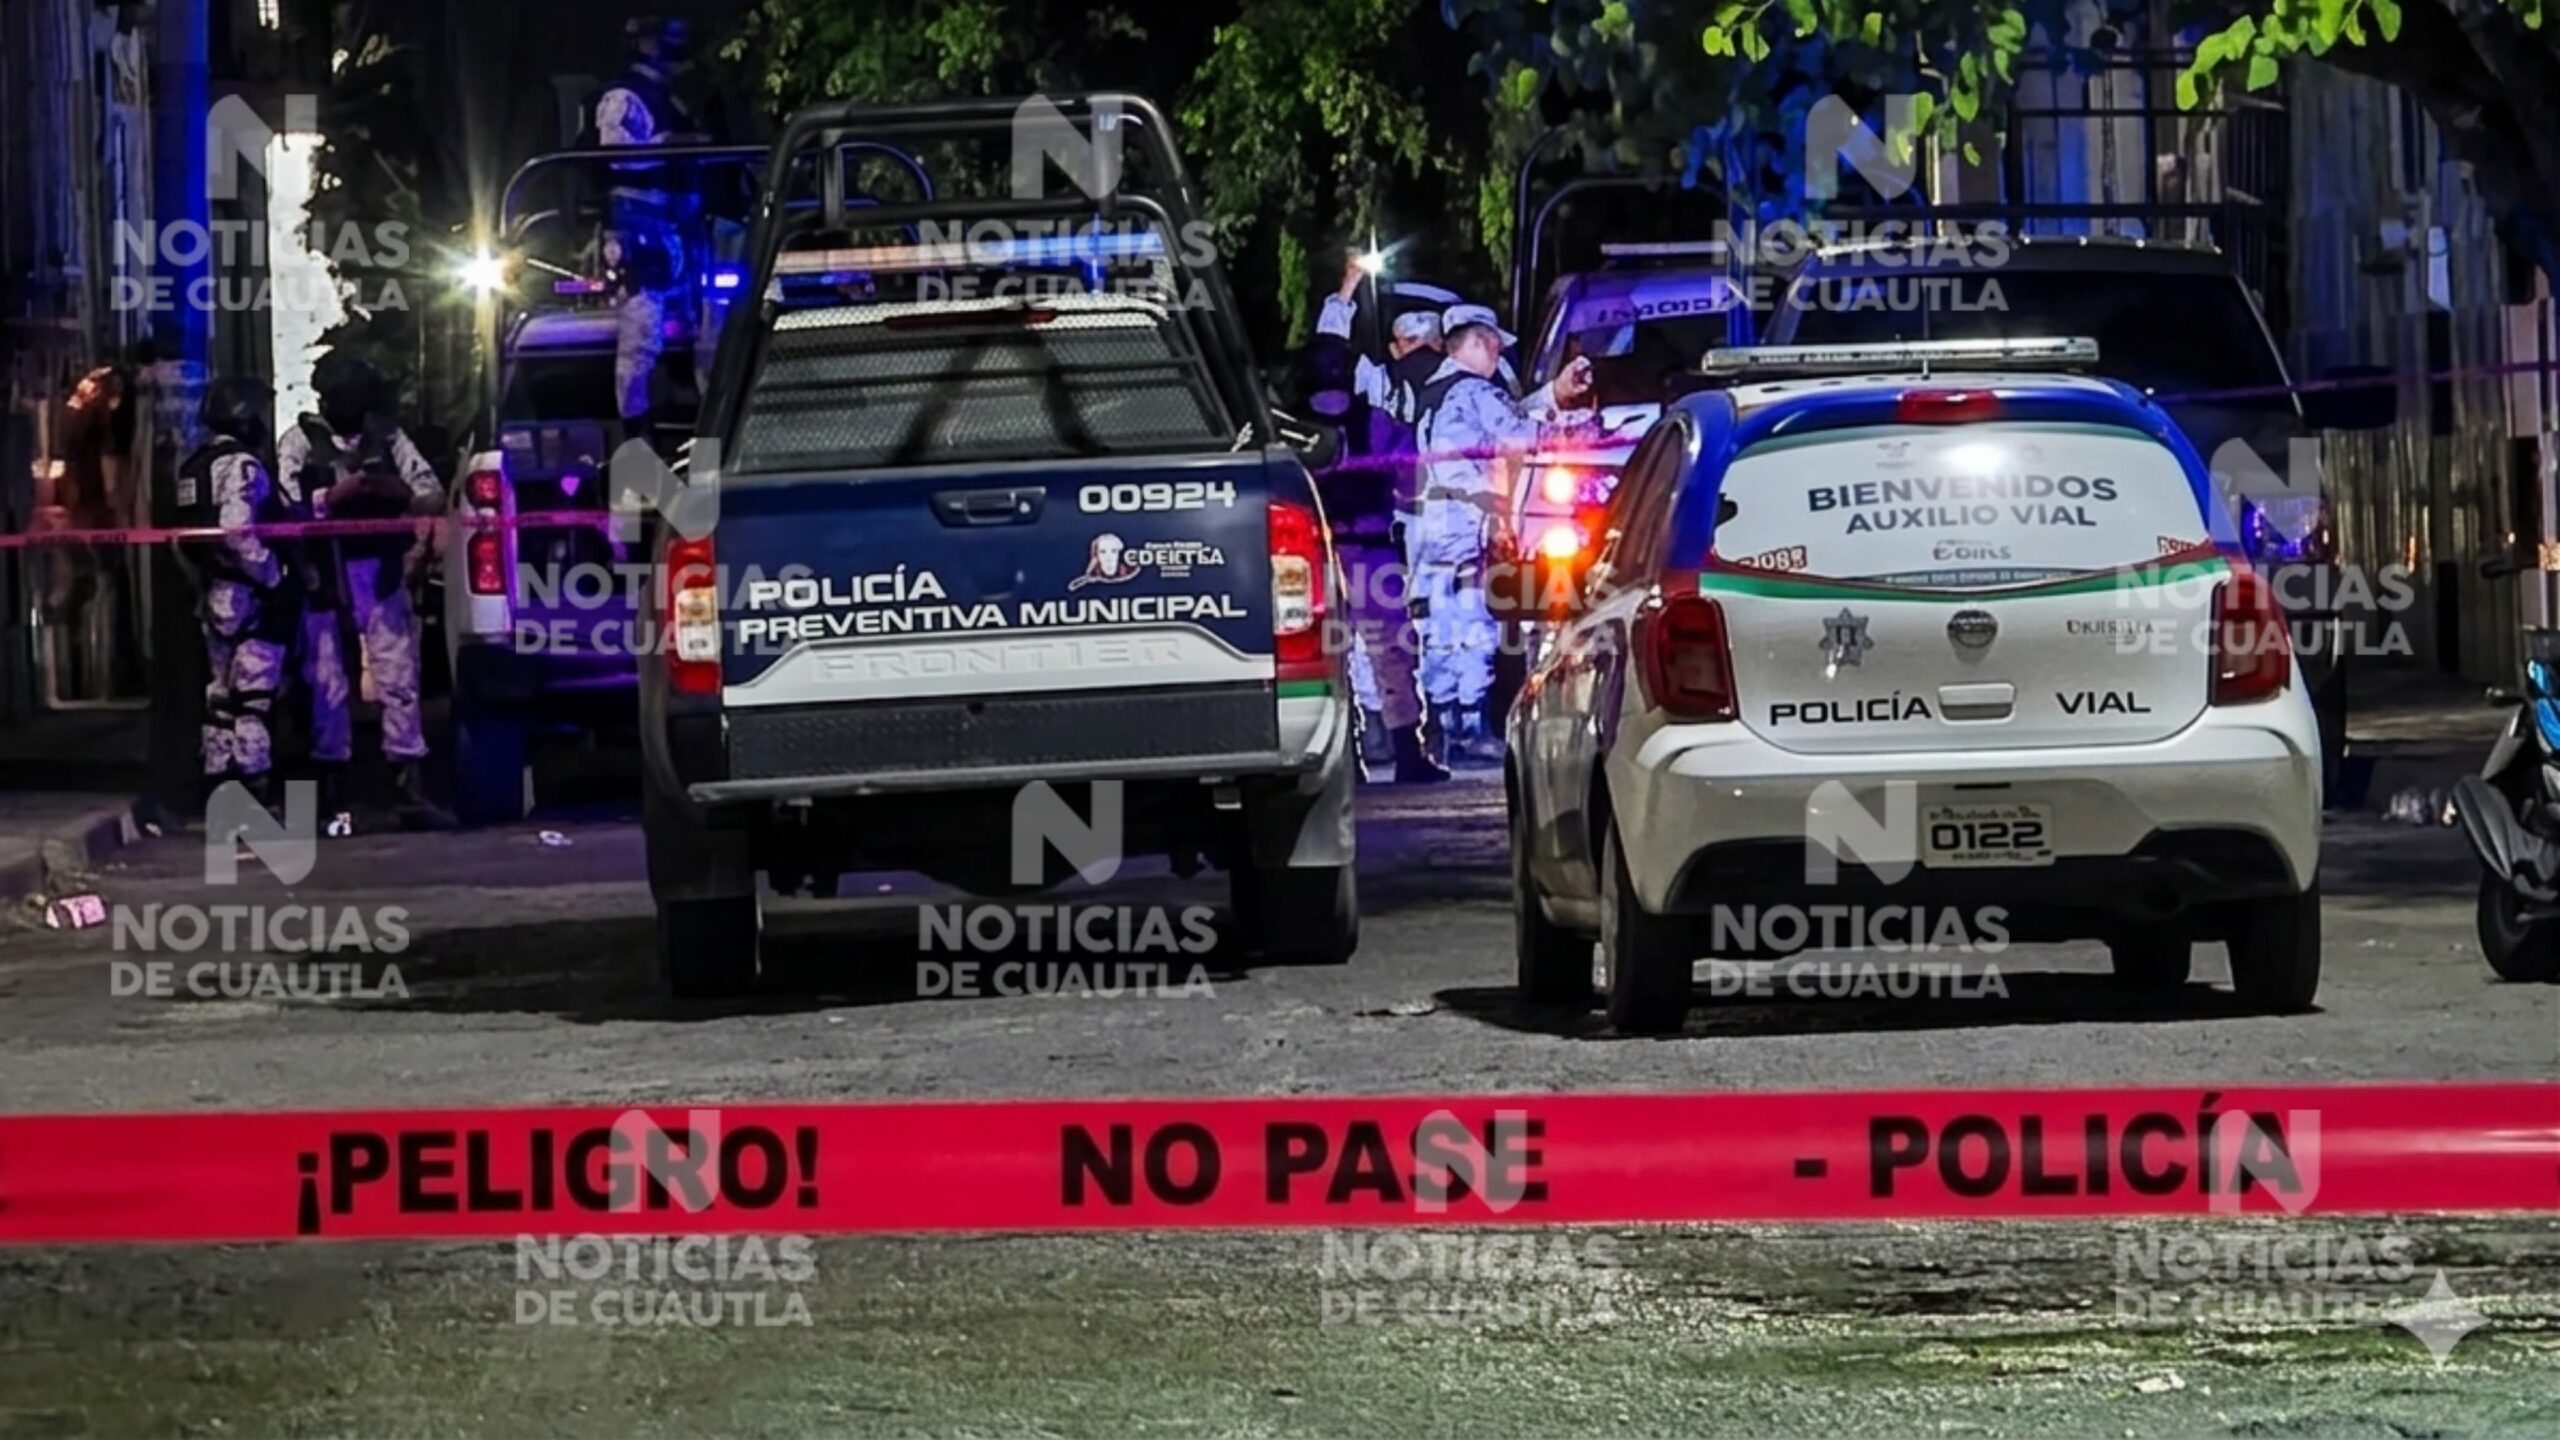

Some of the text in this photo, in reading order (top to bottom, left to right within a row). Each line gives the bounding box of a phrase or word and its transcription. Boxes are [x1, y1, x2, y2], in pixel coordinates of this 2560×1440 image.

[1079, 481, 1236, 512] 00924
[1808, 475, 2118, 513] BIENVENIDOS
[1846, 504, 2097, 534] AUXILIO VIAL
[749, 564, 945, 610] POLICÍA
[740, 595, 1247, 643] PREVENTIVA MUNICIPAL
[817, 638, 1182, 679] FRONTIER
[1771, 691, 2151, 726] POLICÍA VIAL
[1931, 821, 2045, 850] 0122
[297, 1126, 821, 1234] ¡PELIGRO!
[1060, 1123, 1222, 1206] NO
[1264, 1119, 1549, 1205] PASE
[1869, 1092, 2304, 1199] POLICÍA
